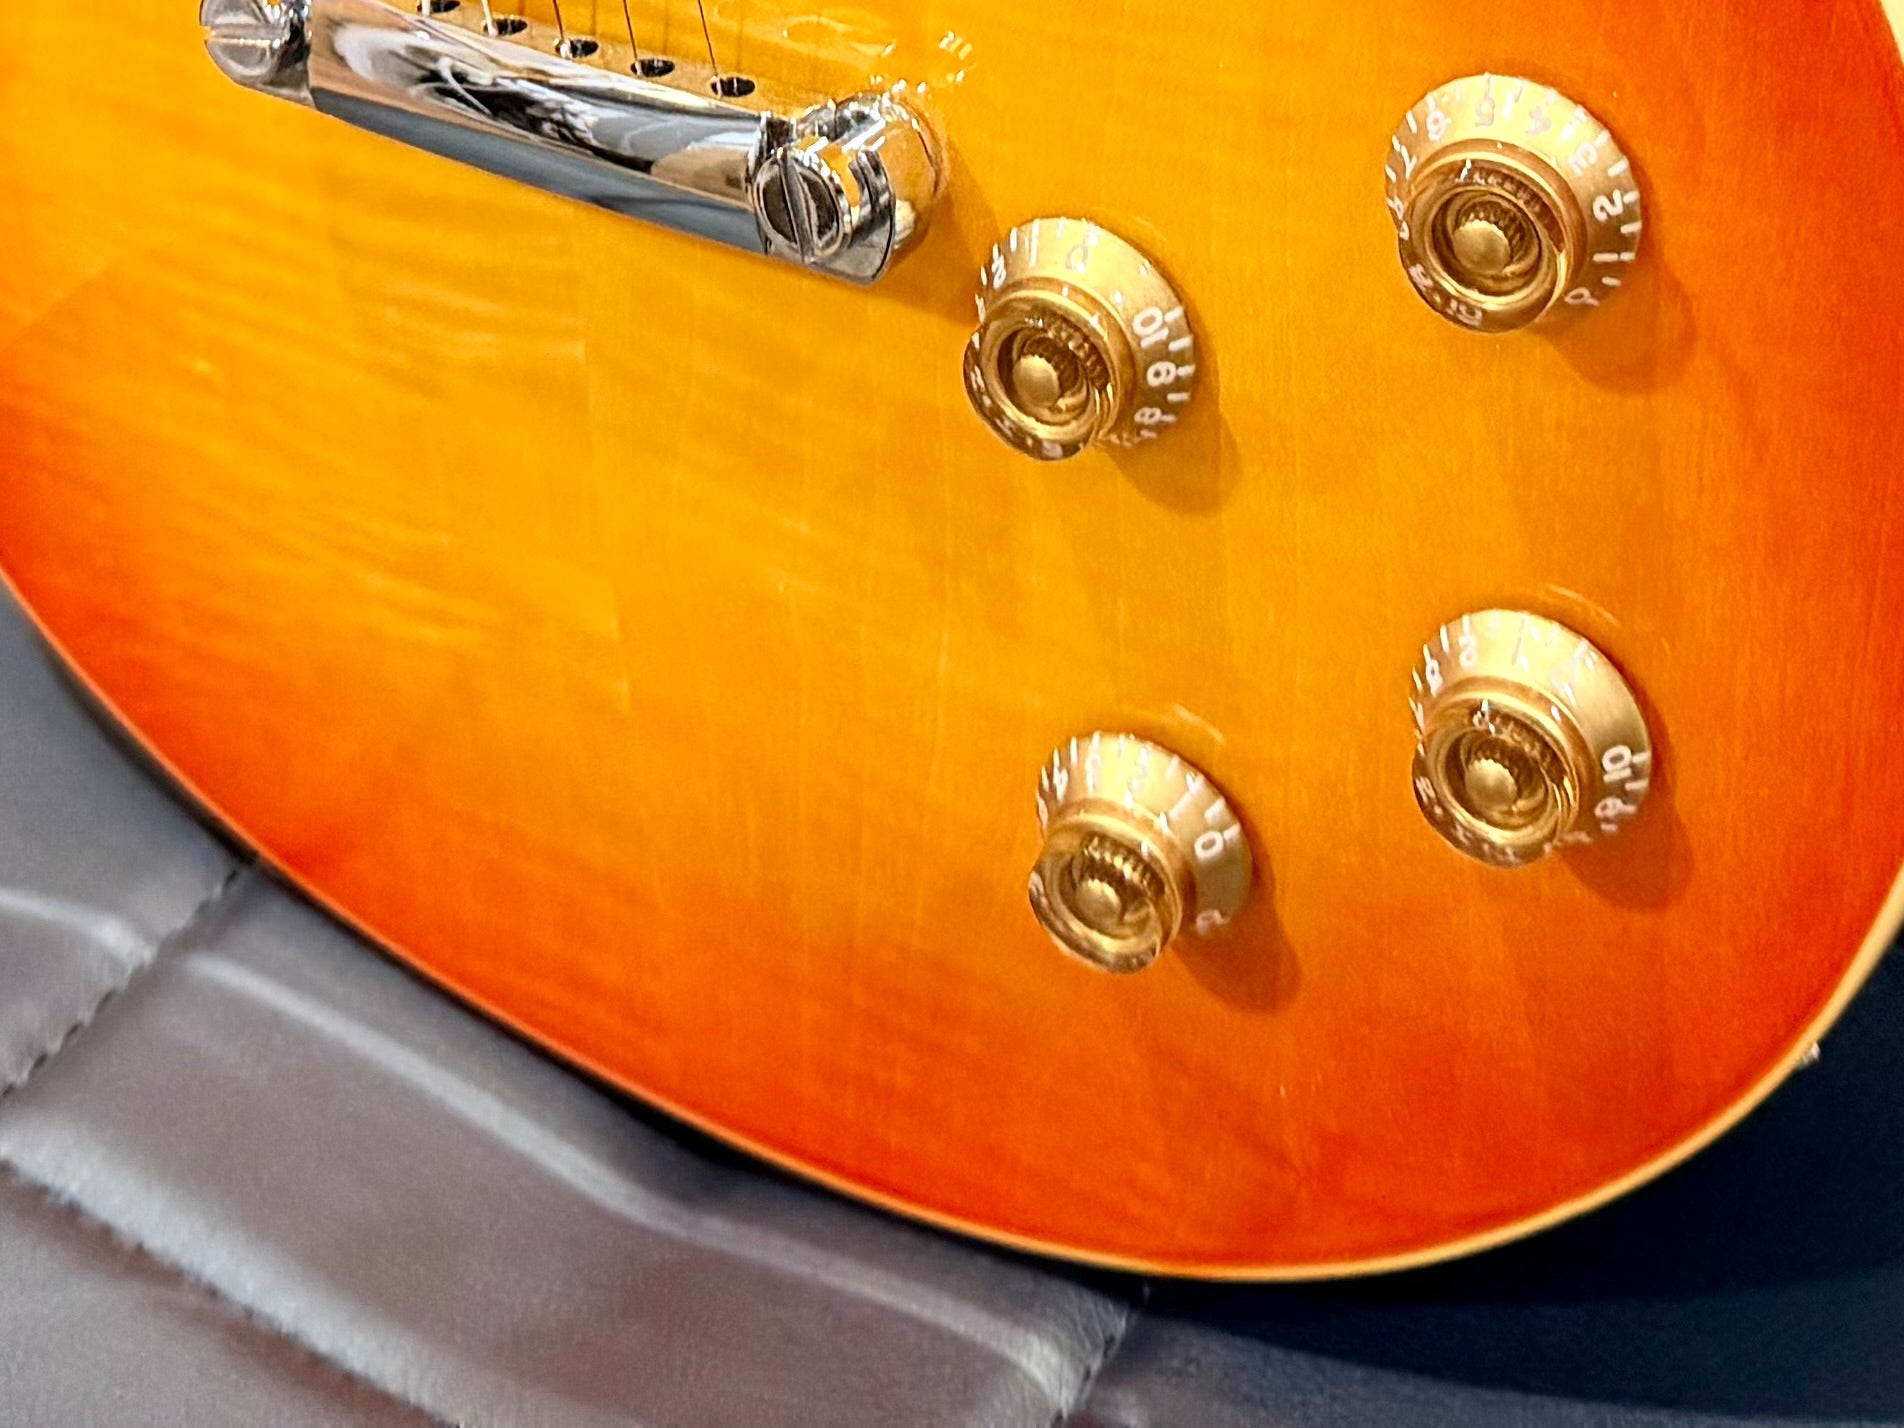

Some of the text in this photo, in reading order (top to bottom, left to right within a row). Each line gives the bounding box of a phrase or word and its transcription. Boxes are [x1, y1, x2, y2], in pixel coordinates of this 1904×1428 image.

[1592, 189, 1625, 224] 2
[1132, 306, 1170, 349] 10
[1601, 744, 1633, 784] 10
